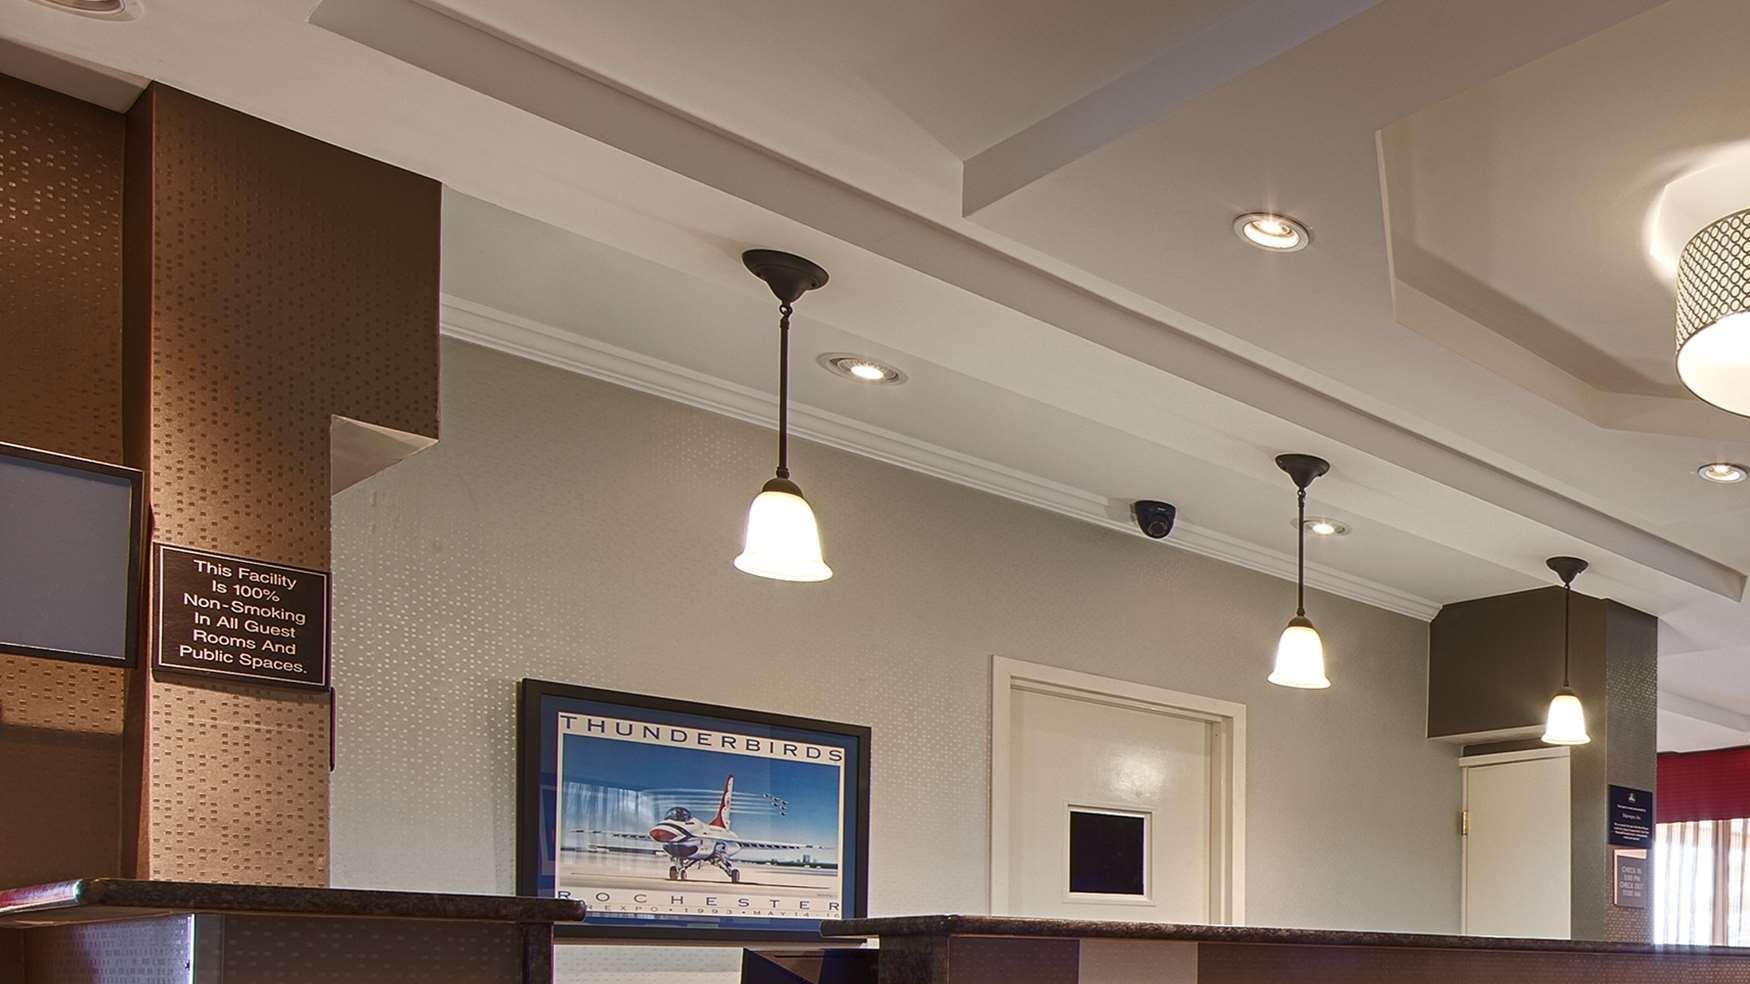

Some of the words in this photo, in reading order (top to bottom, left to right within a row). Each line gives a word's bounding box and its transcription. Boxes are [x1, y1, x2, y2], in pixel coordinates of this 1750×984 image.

[193, 559, 232, 577] This
[238, 567, 297, 590] Facility
[212, 580, 227, 594] Is
[233, 584, 280, 602] 100%
[183, 593, 306, 625] Non-Smoking
[194, 612, 211, 625] In
[216, 615, 239, 630] All
[244, 620, 296, 639] Guest
[193, 629, 256, 649] Rooms
[261, 640, 296, 655] And
[179, 645, 234, 664] Public
[239, 653, 308, 674] Spaces.
[560, 715, 843, 762] THUNDERBIRDS
[558, 890, 840, 911] ROCHESTER
